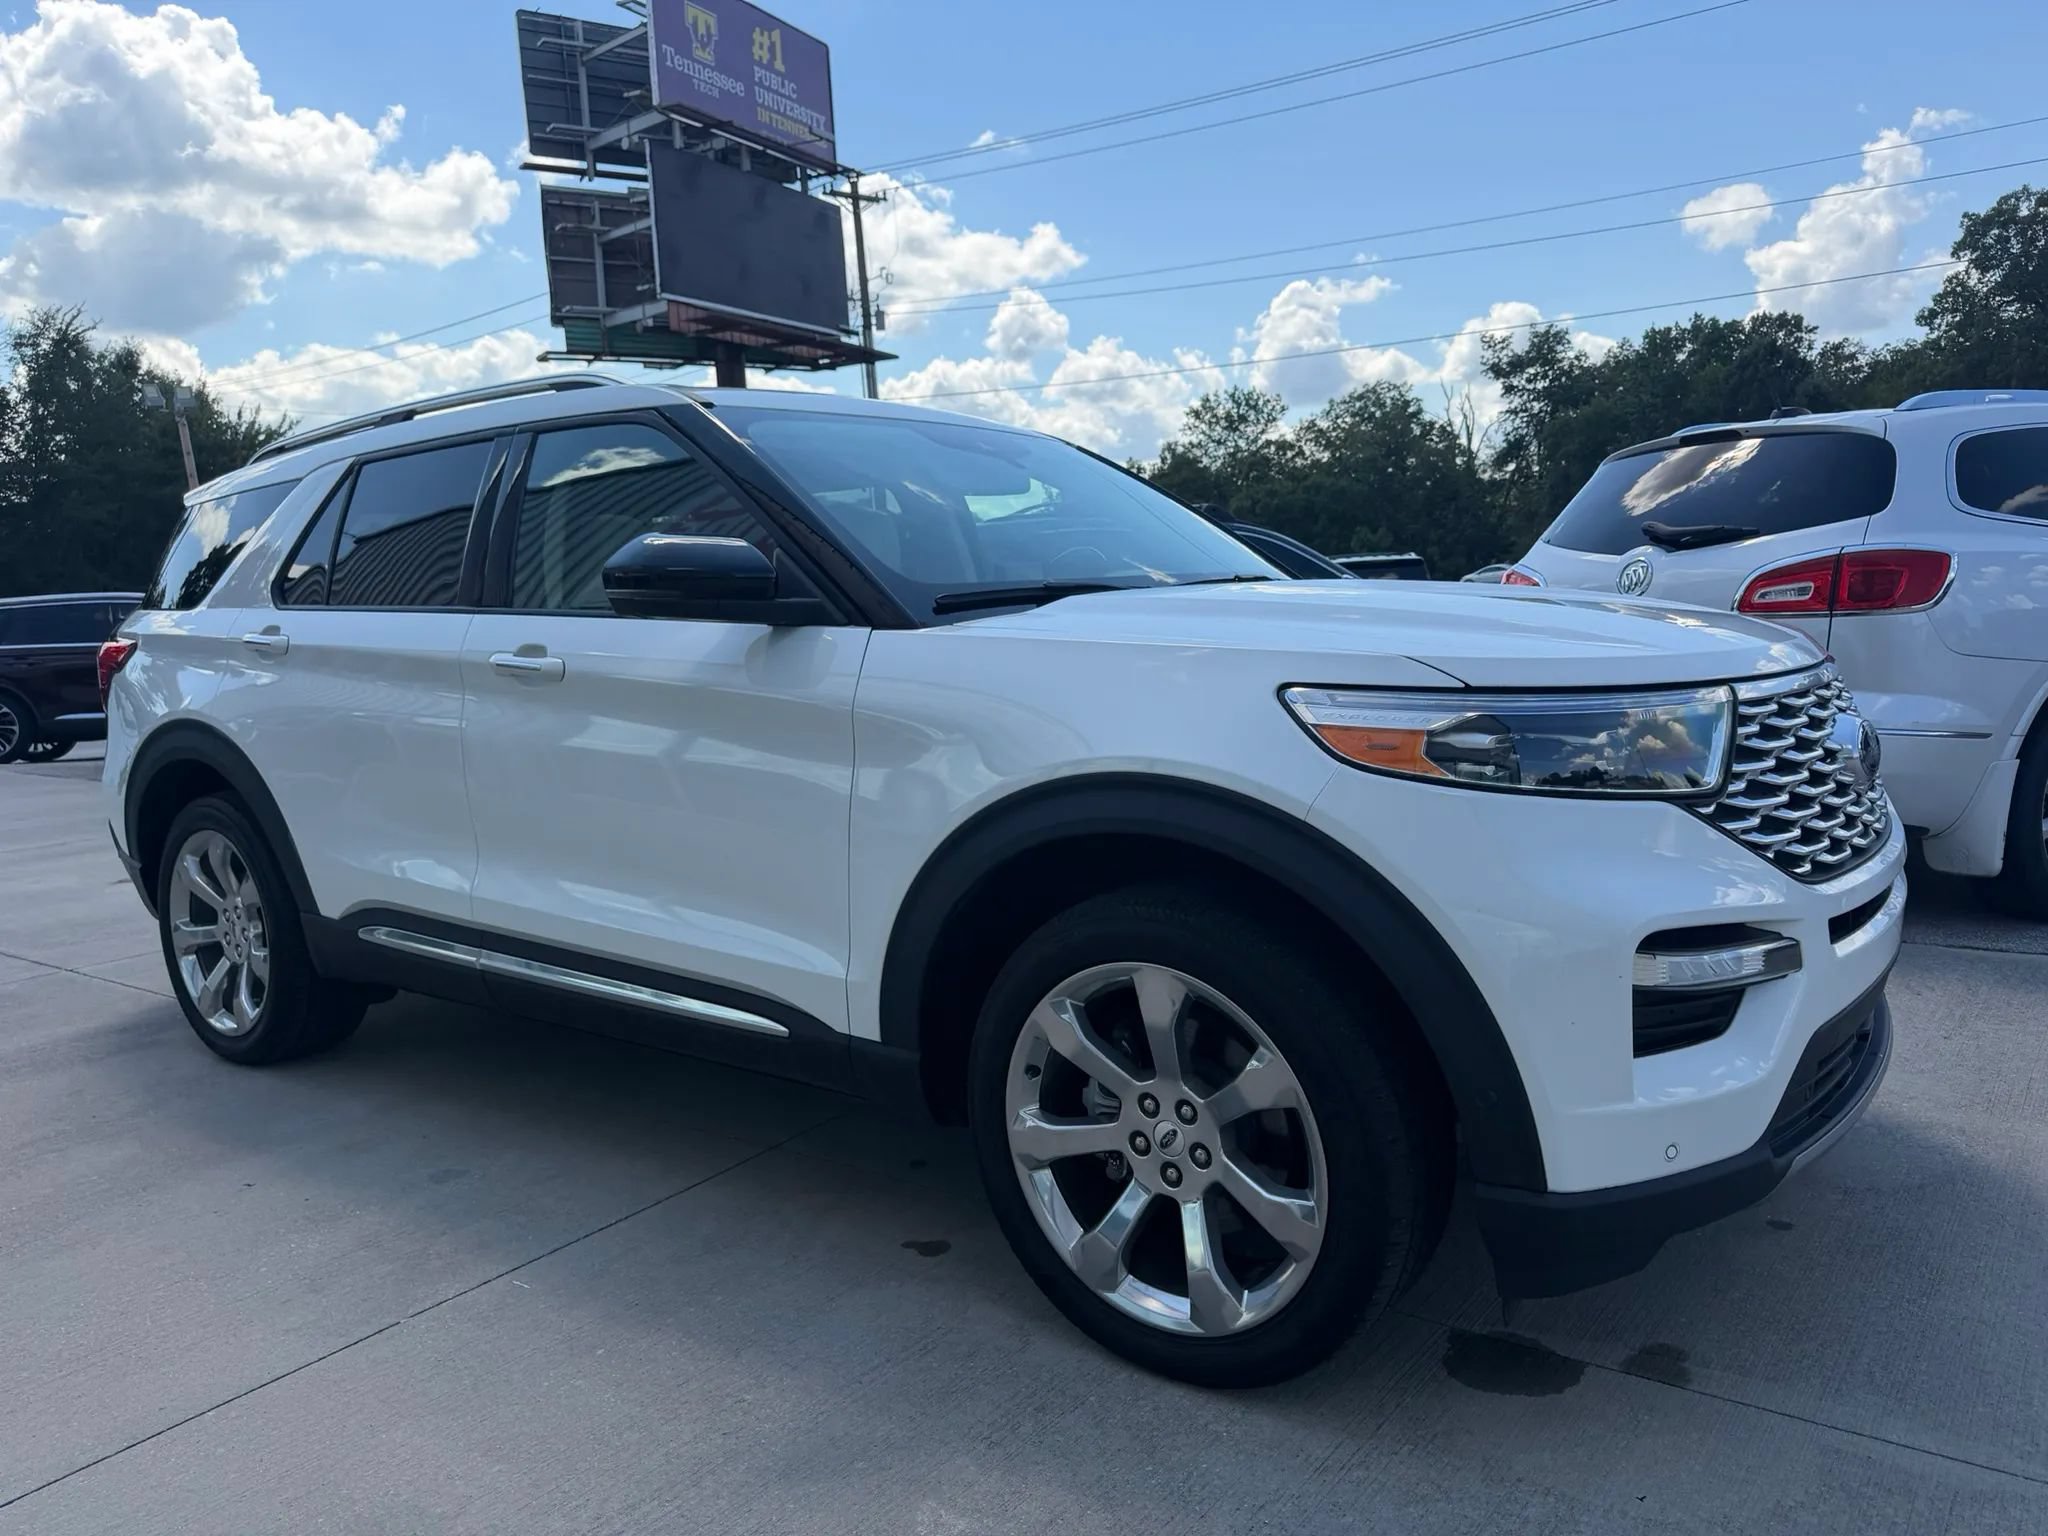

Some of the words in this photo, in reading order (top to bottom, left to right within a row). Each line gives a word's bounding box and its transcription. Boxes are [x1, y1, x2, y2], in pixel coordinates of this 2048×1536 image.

[662, 44, 744, 96] Tennessee
[752, 27, 785, 72] #1
[692, 78, 719, 98] TECH
[753, 65, 797, 99] PUBLIC
[754, 86, 826, 130] UNIVERSITY
